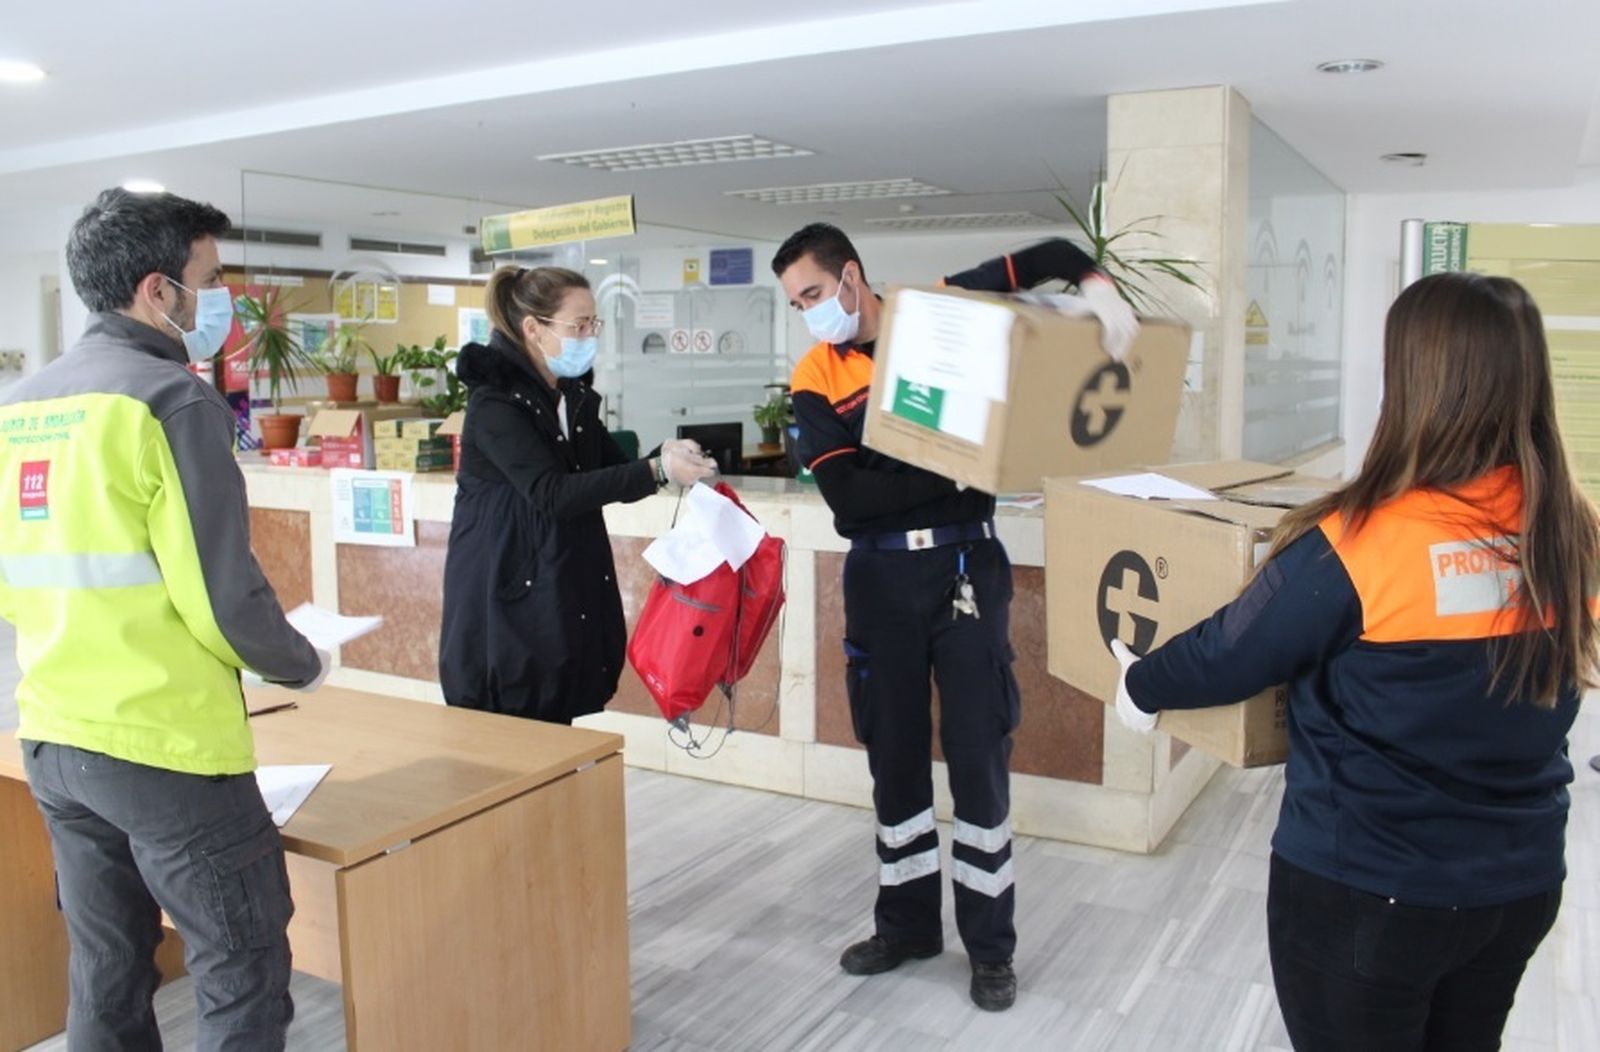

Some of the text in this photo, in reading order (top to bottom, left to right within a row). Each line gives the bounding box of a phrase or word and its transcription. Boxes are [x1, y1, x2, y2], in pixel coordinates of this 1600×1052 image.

[578, 222, 590, 234] del
[592, 217, 630, 231] Gobierno
[1431, 223, 1449, 272] ALUCIA
[24, 474, 43, 491] 112
